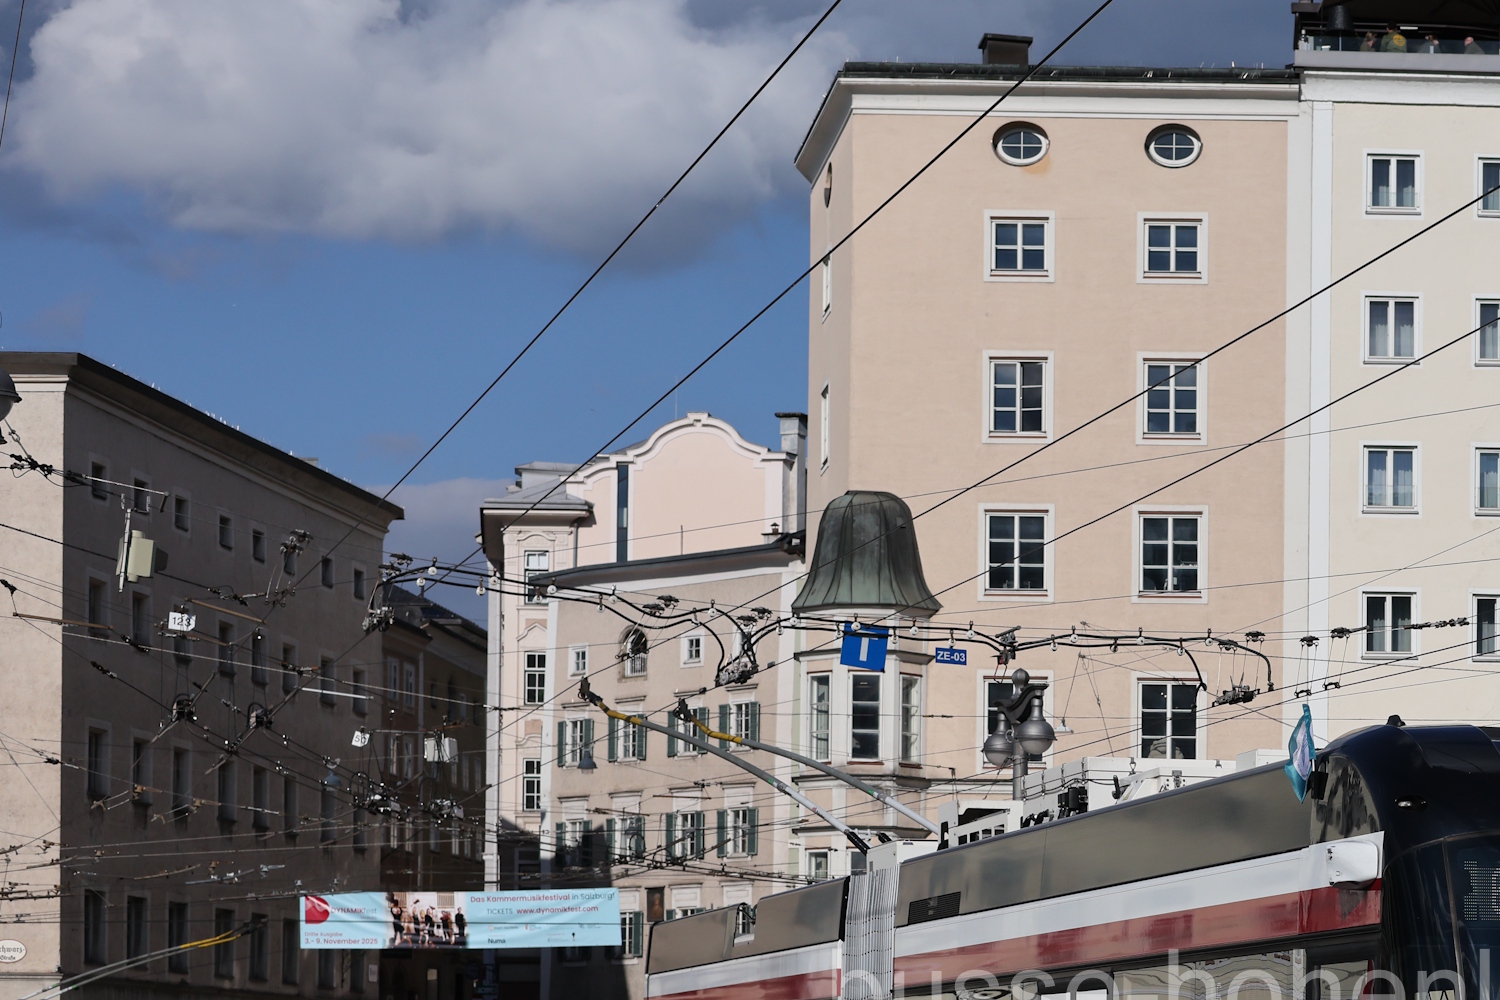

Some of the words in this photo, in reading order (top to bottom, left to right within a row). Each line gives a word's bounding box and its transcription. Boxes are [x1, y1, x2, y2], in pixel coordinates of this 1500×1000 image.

[936, 651, 966, 662] ZE-03
[486, 893, 570, 902] Kammermusikfestival
[516, 906, 599, 915] www.dynamikfest.com
